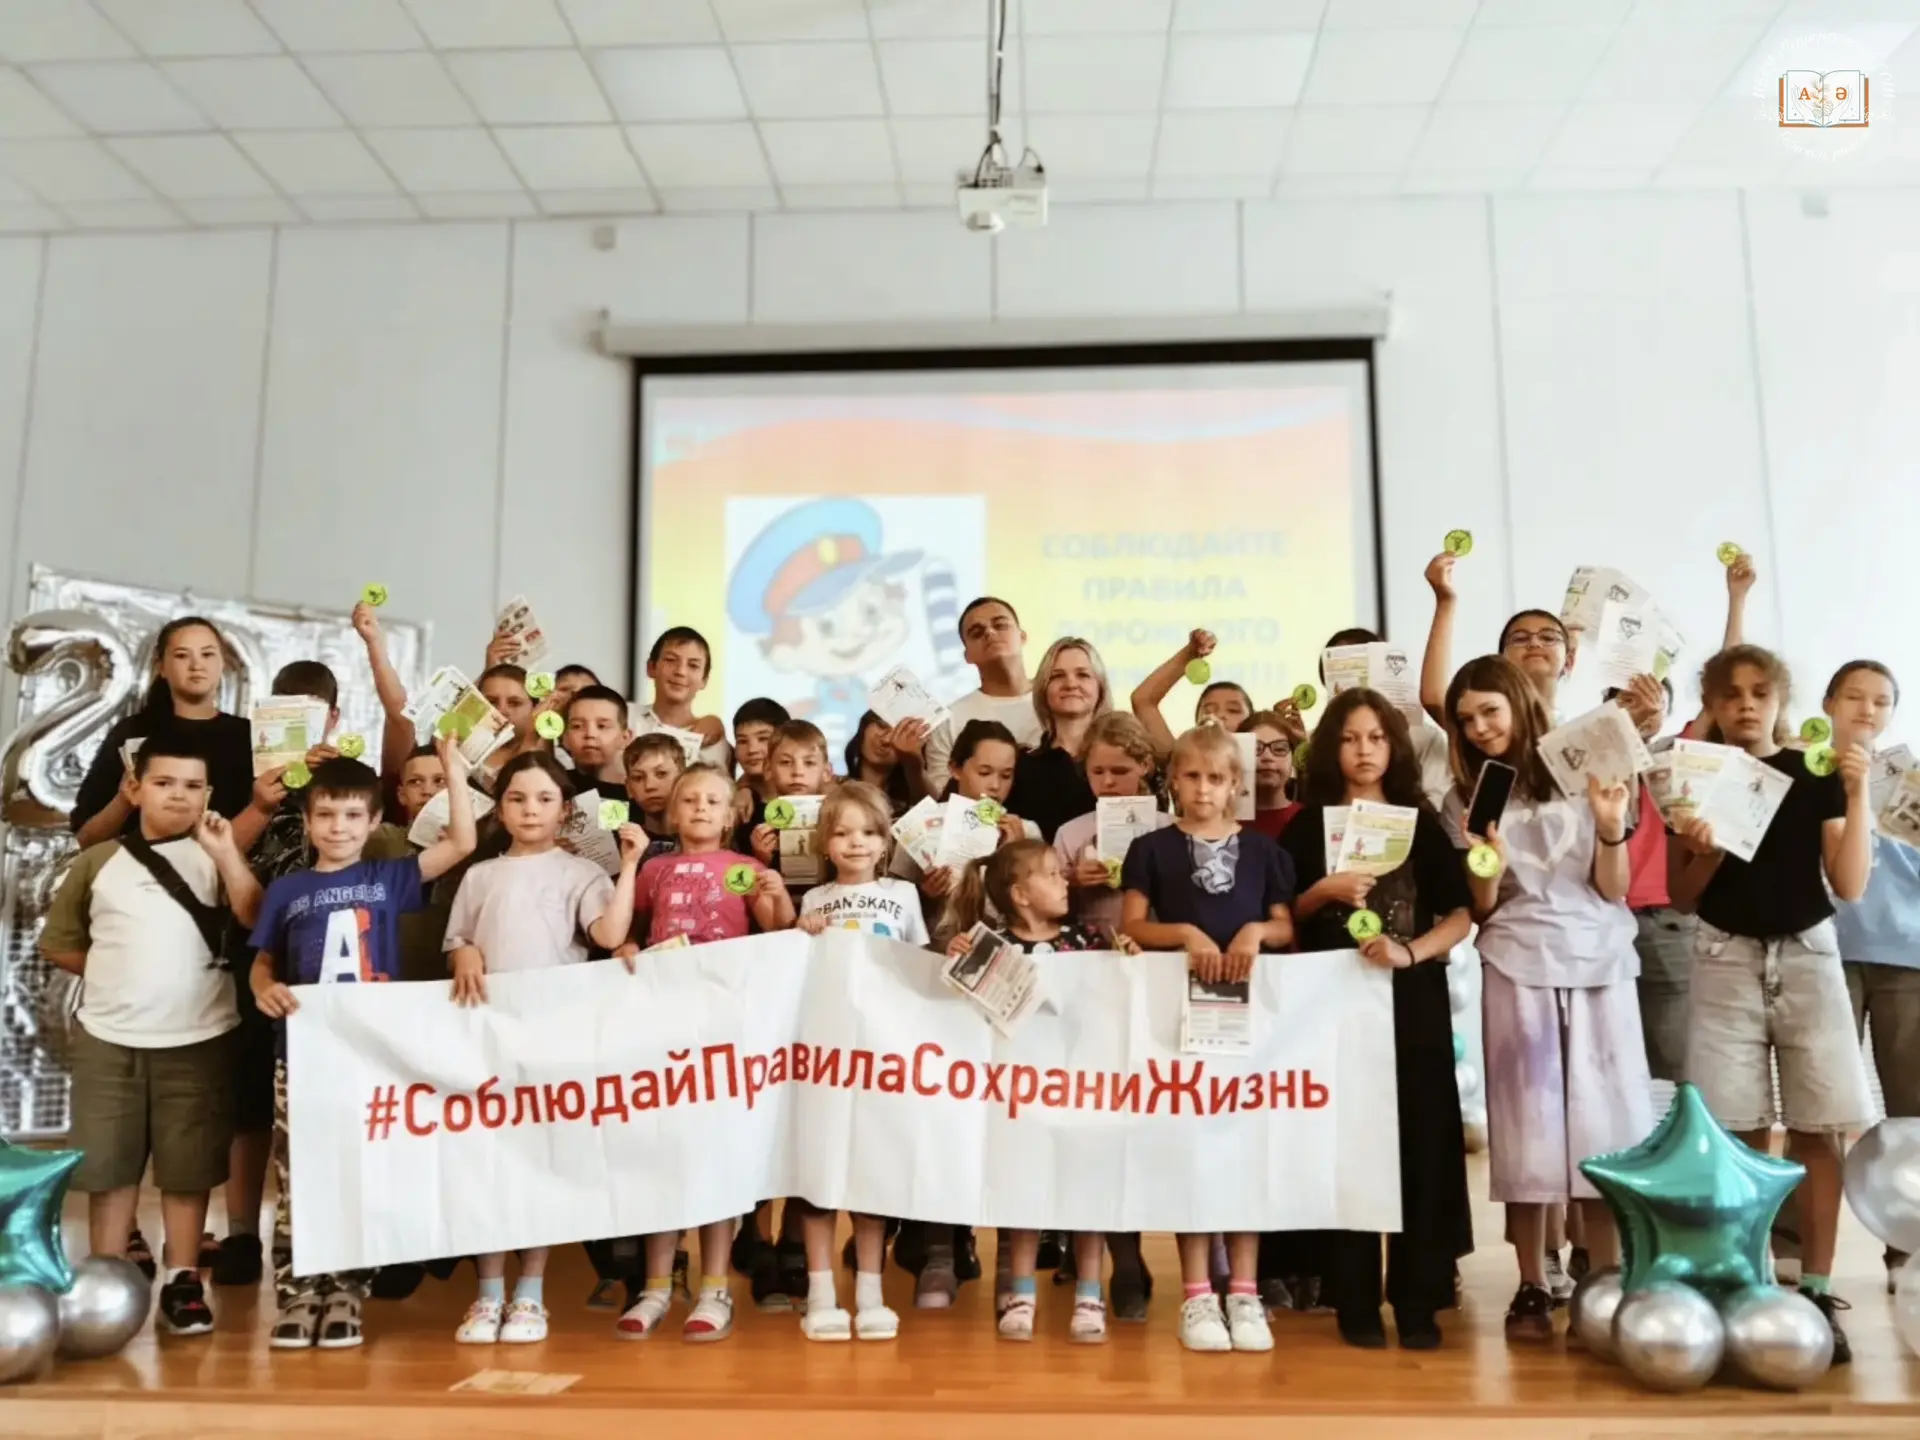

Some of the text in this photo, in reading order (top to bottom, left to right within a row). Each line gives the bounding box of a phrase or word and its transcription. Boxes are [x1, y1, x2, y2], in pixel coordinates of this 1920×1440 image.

[1042, 529, 1289, 562] СОБЛЮДАЙТЕ
[1082, 575, 1248, 602] ПРАВИЛА
[857, 895, 903, 920] SKATE
[368, 1043, 1330, 1138] #СоблюдайПравилаСохраниЖизнь
